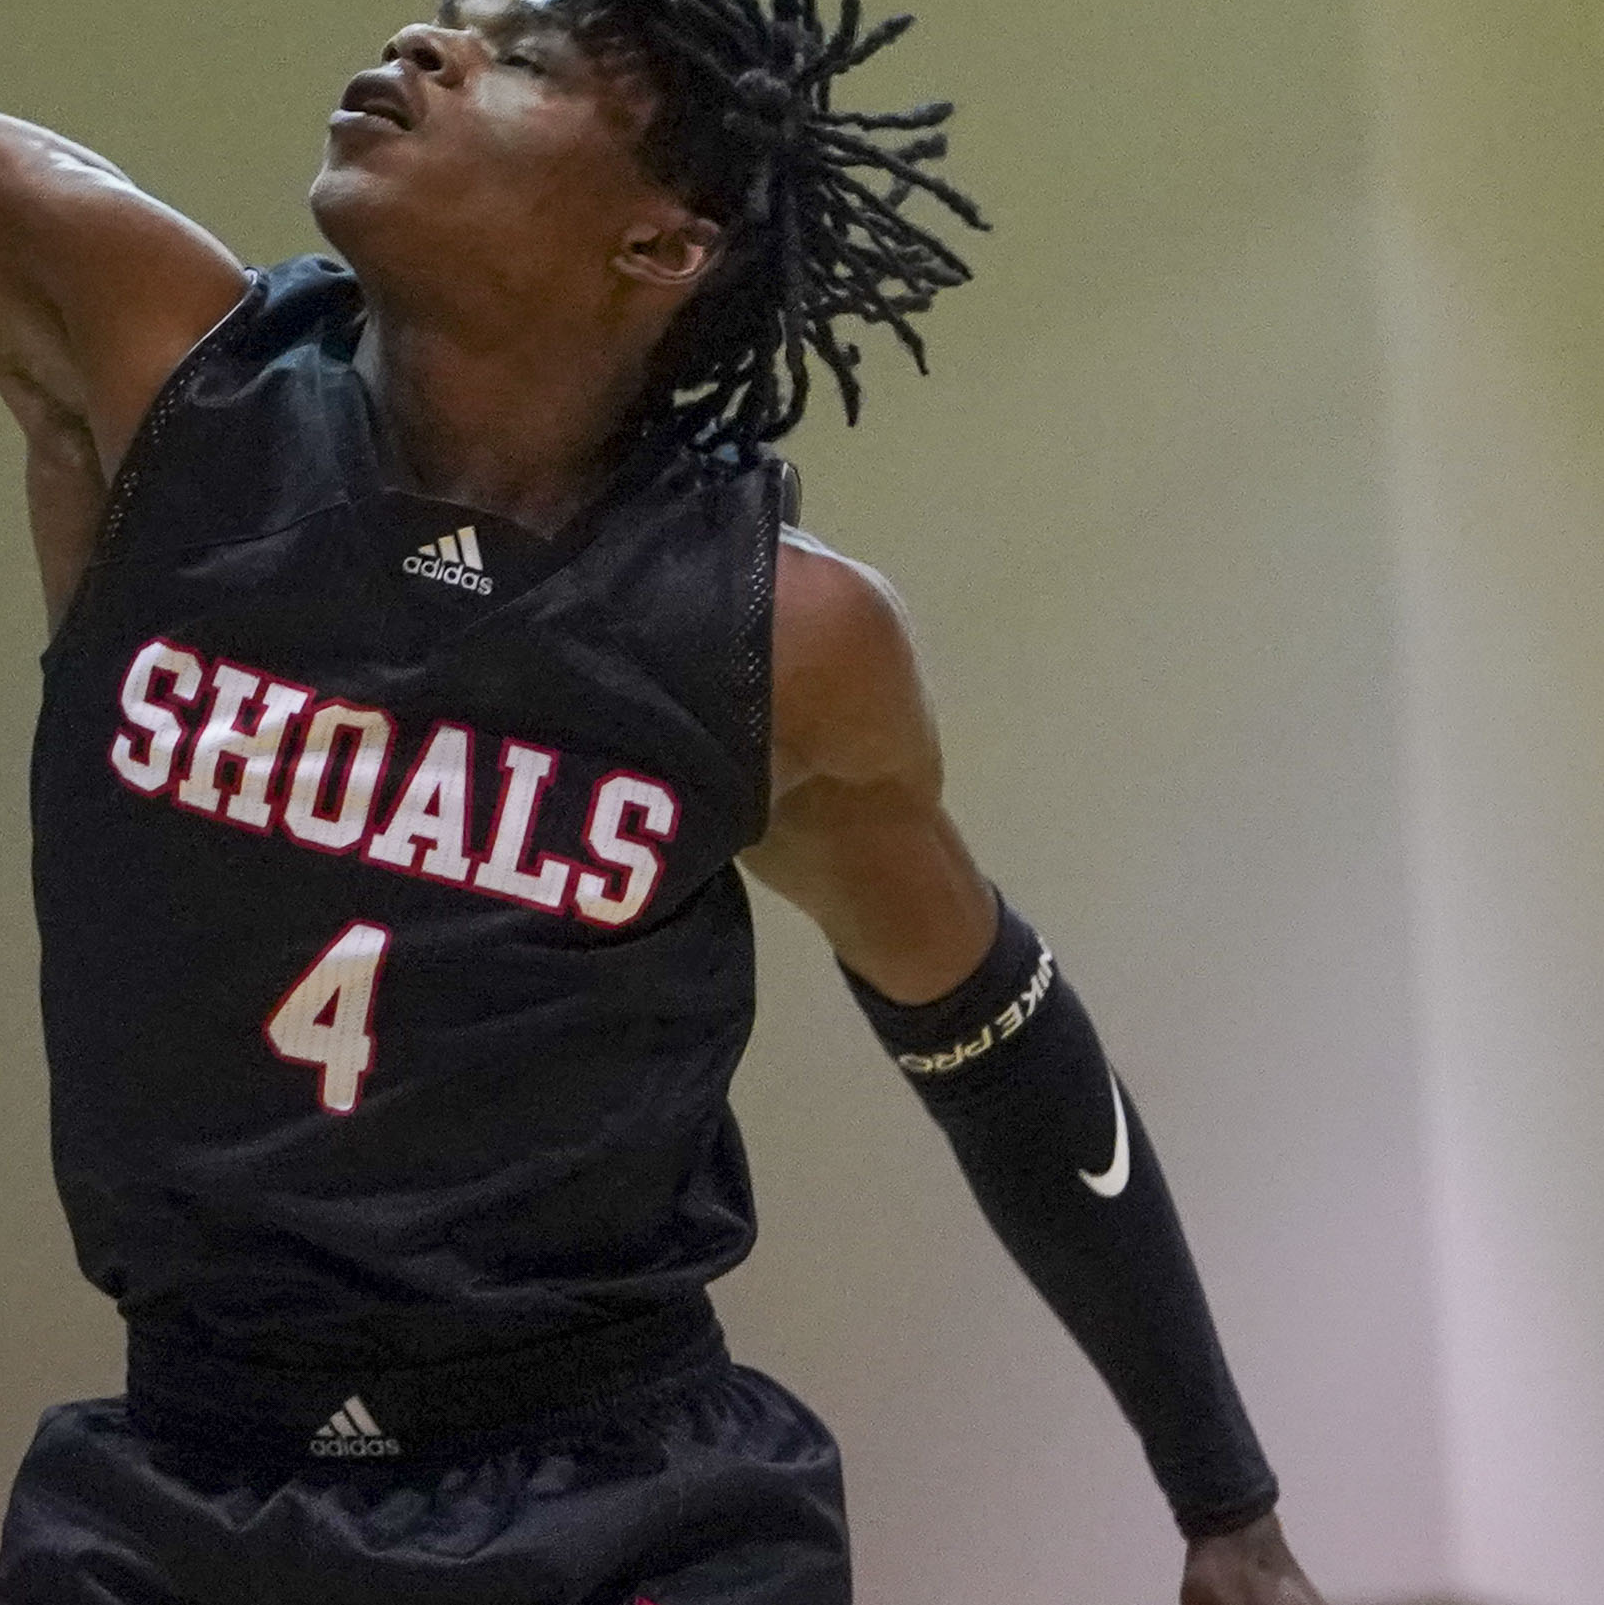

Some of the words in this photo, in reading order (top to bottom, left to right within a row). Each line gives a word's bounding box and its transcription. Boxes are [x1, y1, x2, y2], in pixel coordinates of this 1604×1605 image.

[402, 556, 494, 596] adidas
[109, 638, 680, 928] SHOALS
[264, 919, 391, 1116] 4
[310, 1435, 400, 1456] adidas
